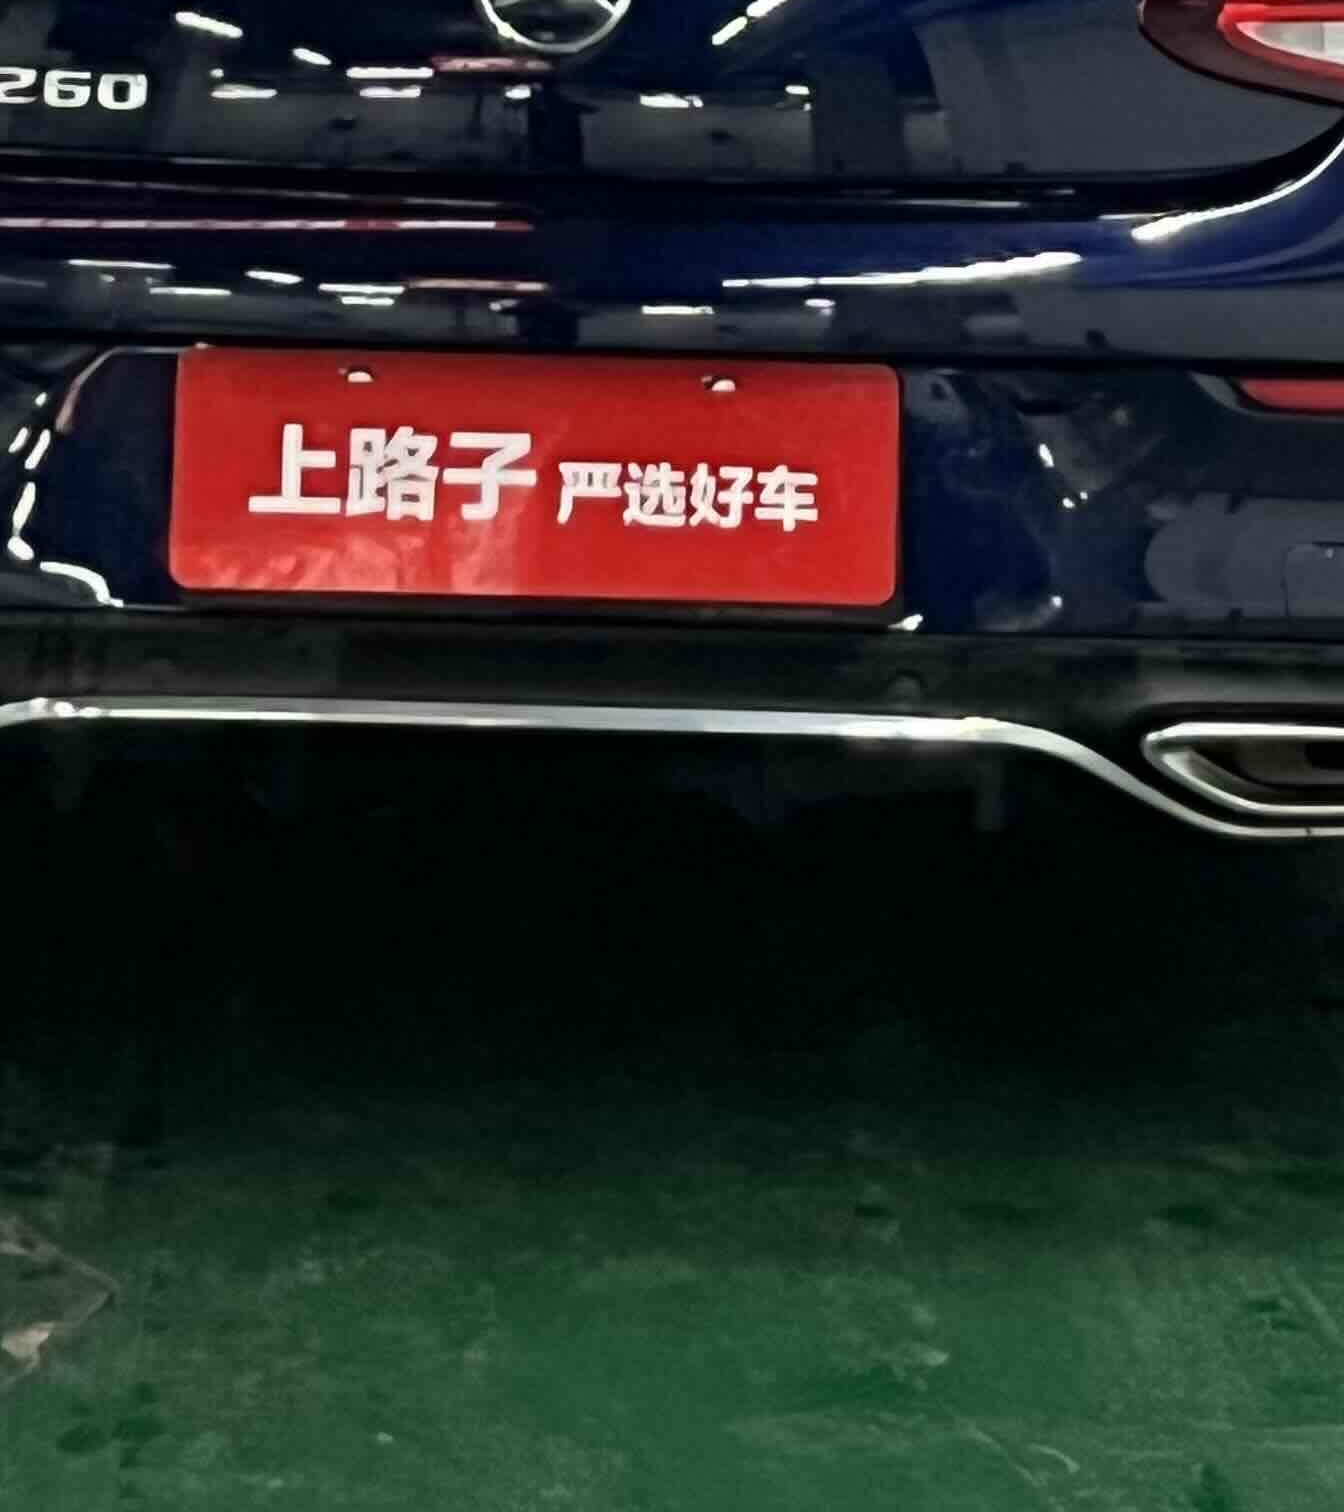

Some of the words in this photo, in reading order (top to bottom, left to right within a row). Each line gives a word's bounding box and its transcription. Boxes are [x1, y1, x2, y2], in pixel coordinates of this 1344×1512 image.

[248, 424, 537, 522] 上路子
[556, 461, 819, 532] 严选好车
